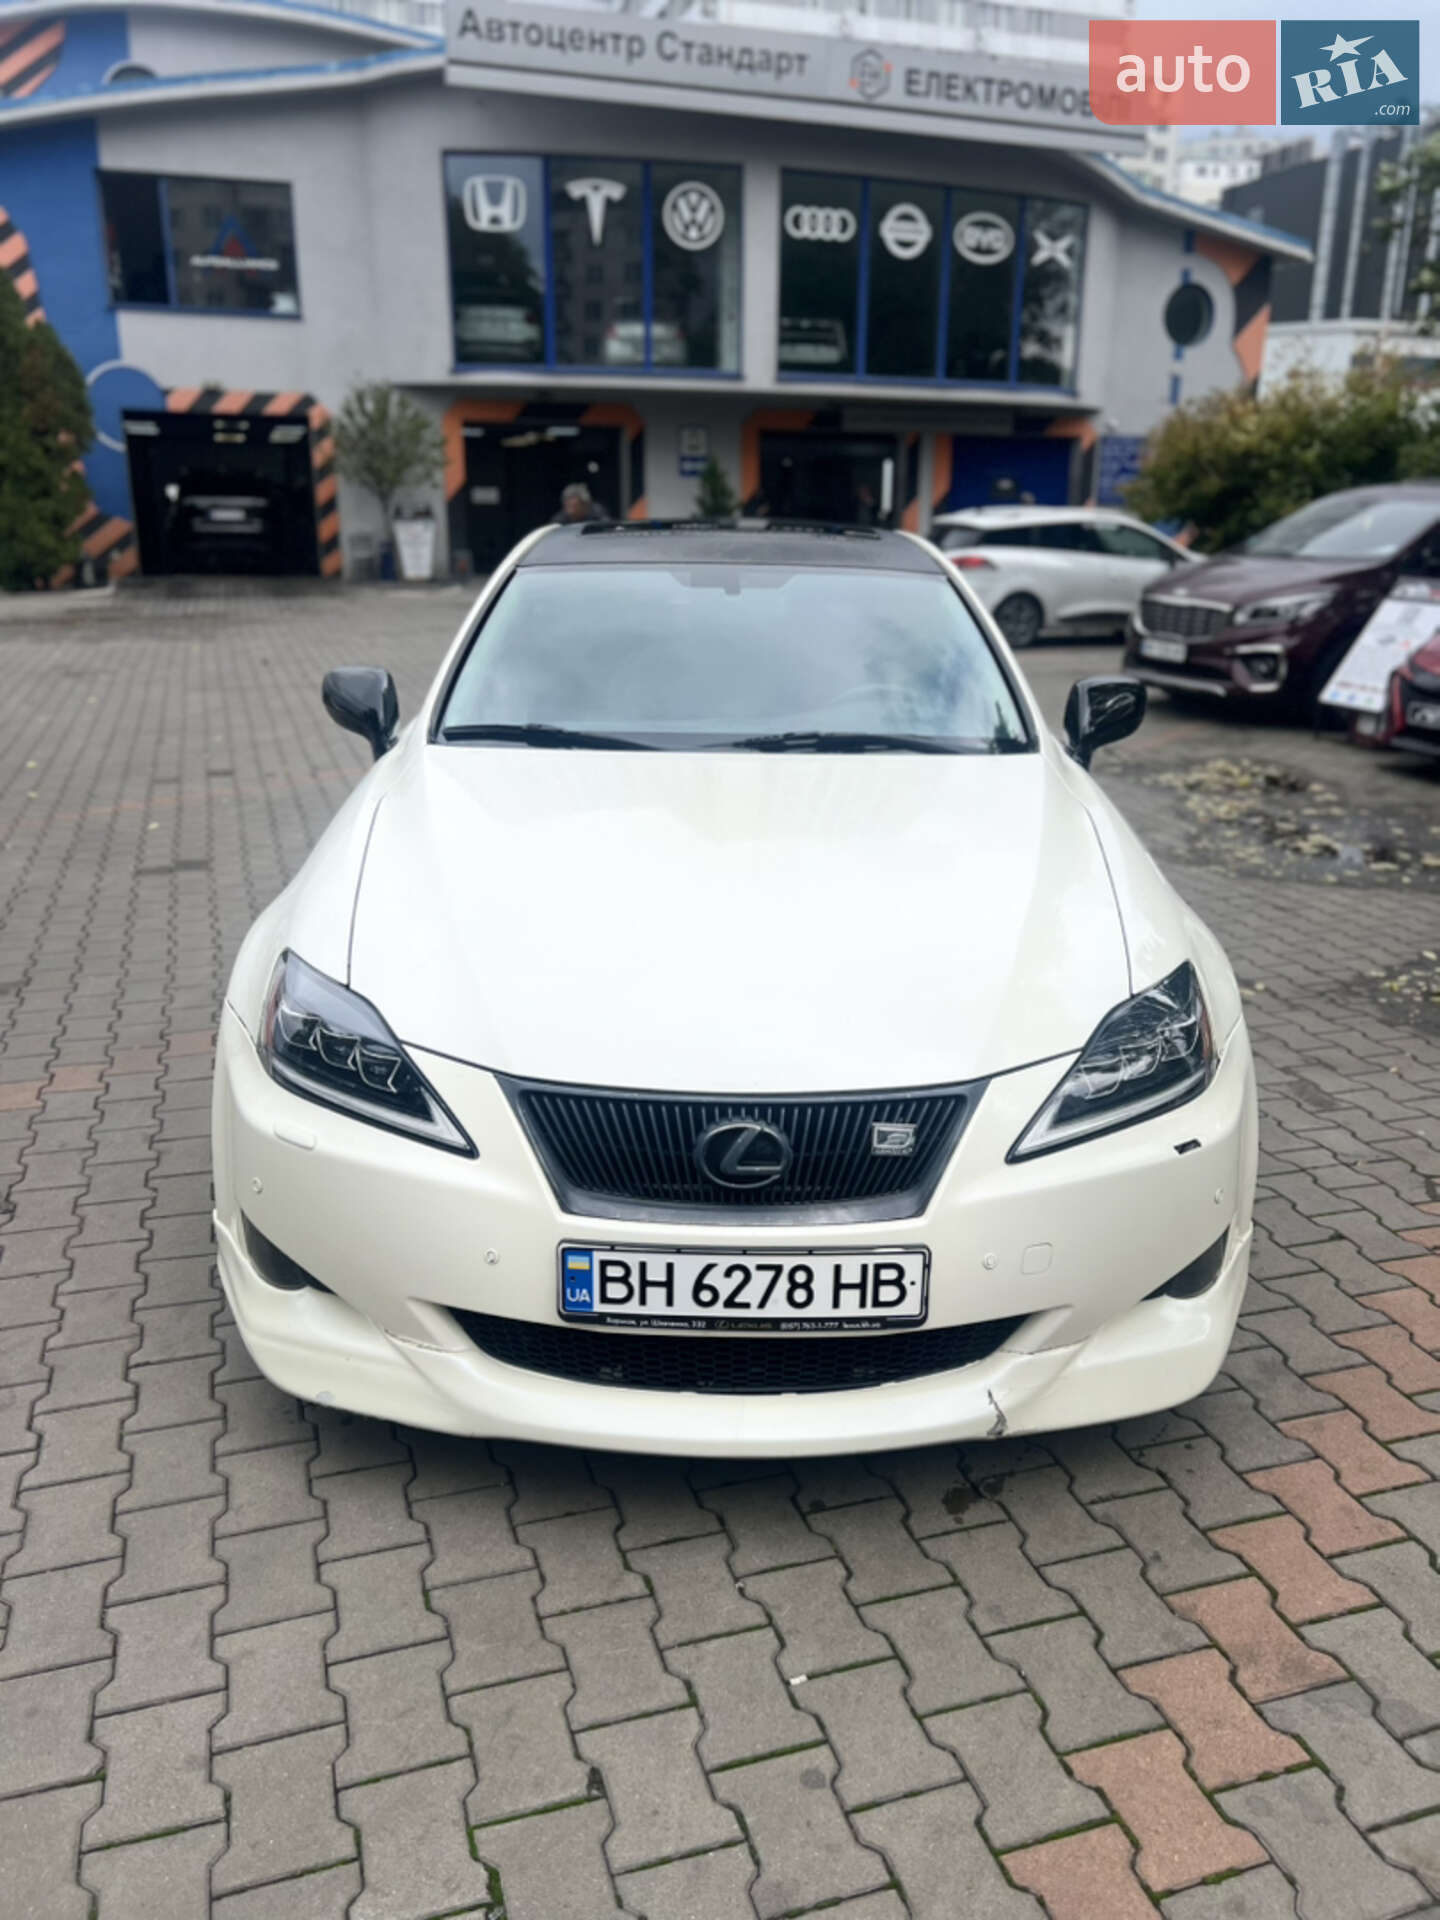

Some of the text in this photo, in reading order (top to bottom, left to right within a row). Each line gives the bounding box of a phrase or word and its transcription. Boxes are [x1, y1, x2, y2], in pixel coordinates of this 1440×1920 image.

[457, 8, 646, 64] Автоцентр
[655, 30, 811, 80] Стандарт
[566, 1287, 591, 1303] UA
[598, 1259, 908, 1310] BH 6278 HB
